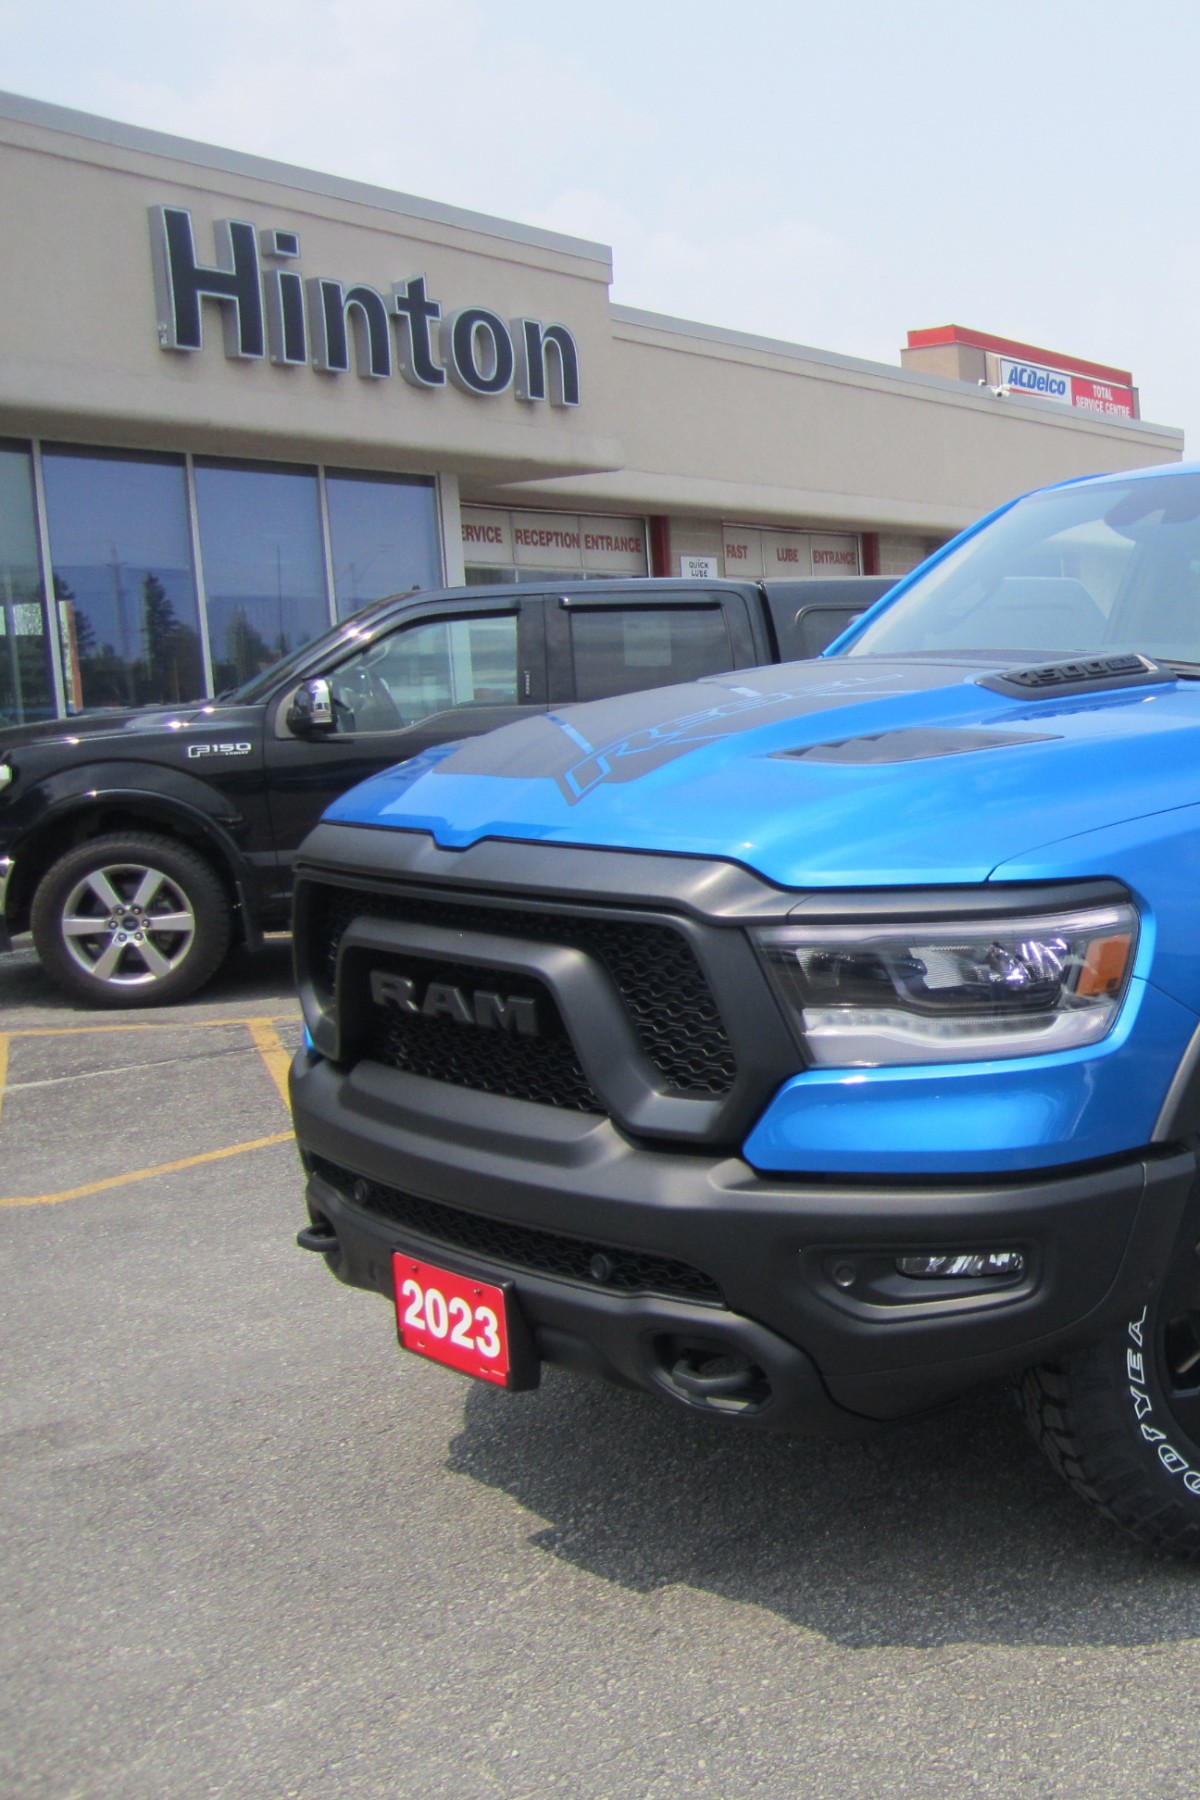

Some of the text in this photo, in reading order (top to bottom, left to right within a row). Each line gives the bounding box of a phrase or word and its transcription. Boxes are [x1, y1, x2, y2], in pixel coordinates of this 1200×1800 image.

[150, 205, 580, 407] Hinton
[1008, 366, 1066, 395] ACDelco
[1093, 385, 1113, 400] TOTAL
[1076, 396, 1130, 417] SERVICE CENTRE
[461, 524, 641, 553] ERVICE RECEPTION ENTRANCE
[688, 561, 709, 570] QUICK
[725, 543, 857, 566] FAST LUBE ENTRANCE
[691, 569, 708, 578] LUBE
[1019, 660, 1108, 685] 1500
[370, 969, 539, 1037] RAM
[402, 1279, 501, 1358] 2023
